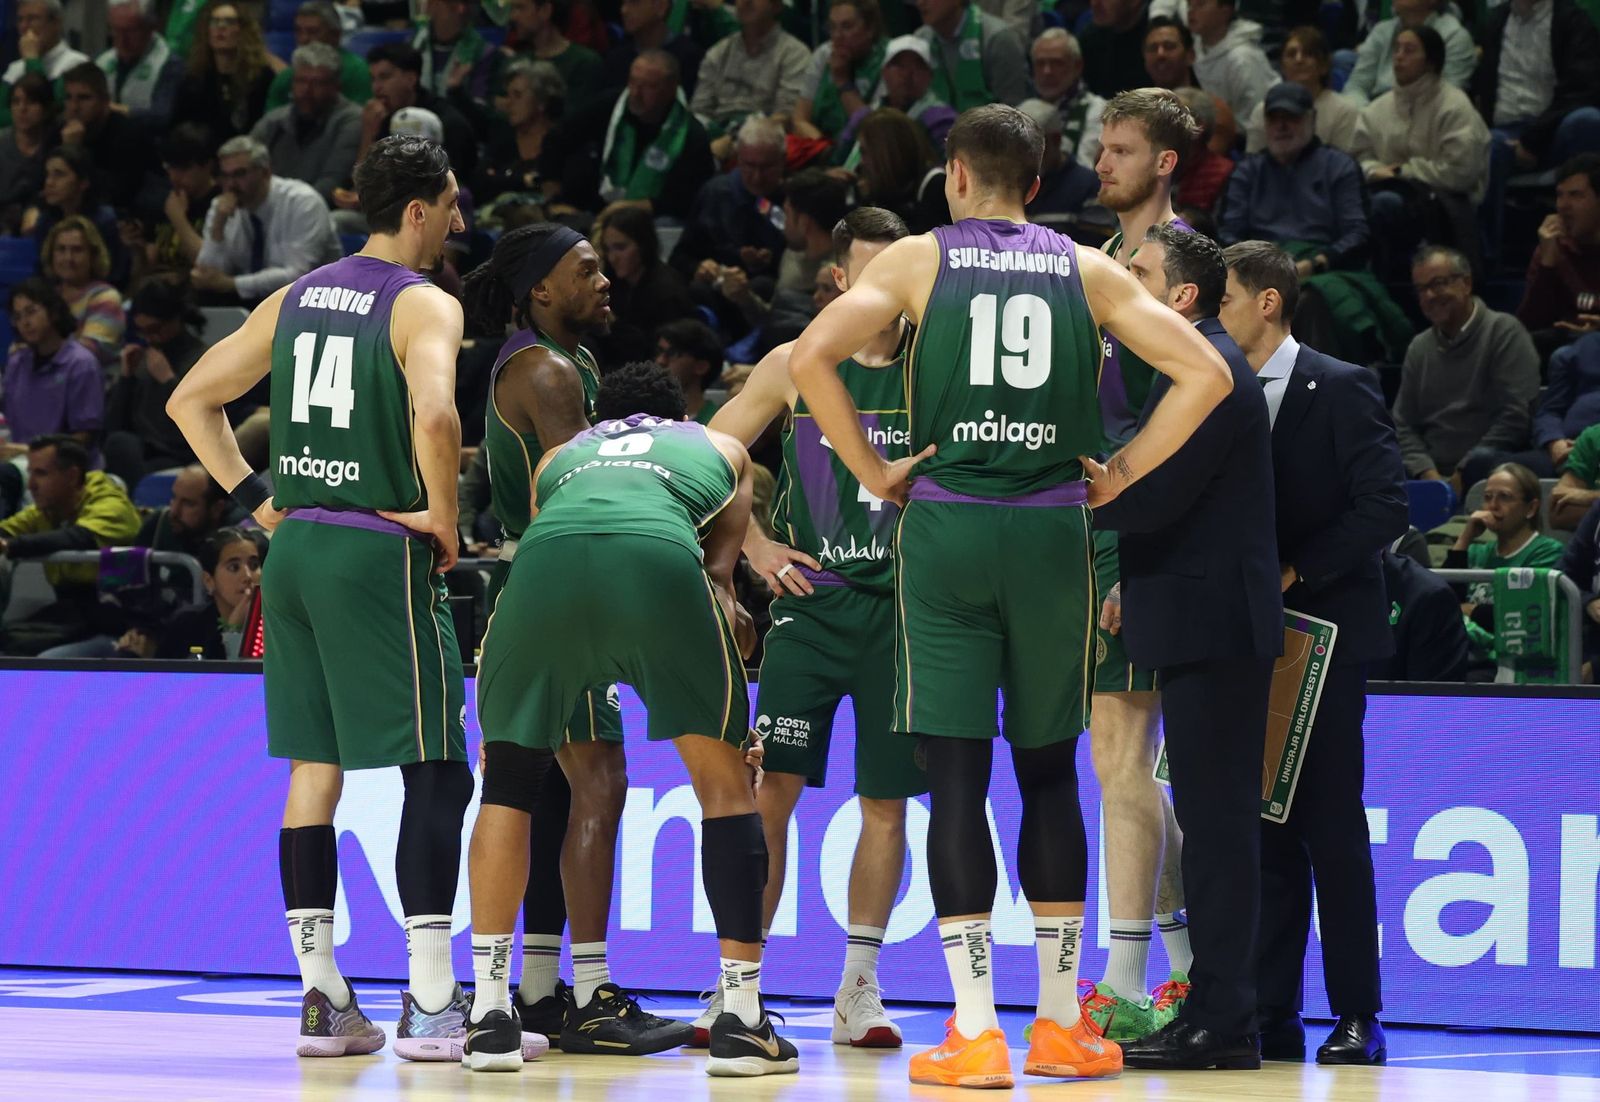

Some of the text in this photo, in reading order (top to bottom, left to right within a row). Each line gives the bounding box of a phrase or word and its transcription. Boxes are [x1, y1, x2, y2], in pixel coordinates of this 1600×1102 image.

[949, 247, 1071, 277] SULEJMANOVIĆ
[969, 293, 1052, 390] 19
[291, 331, 355, 429] 14
[772, 735, 808, 748] MÁLAGA
[773, 726, 809, 740] DEL SOL
[776, 716, 811, 732] COSTA
[1280, 661, 1321, 784] UNICAJA BALONCESTO
[300, 916, 316, 955] NICAJA
[1057, 927, 1079, 974] UNICAJA
[489, 944, 509, 981] UNICAJA
[965, 931, 988, 980] UNICAJA
